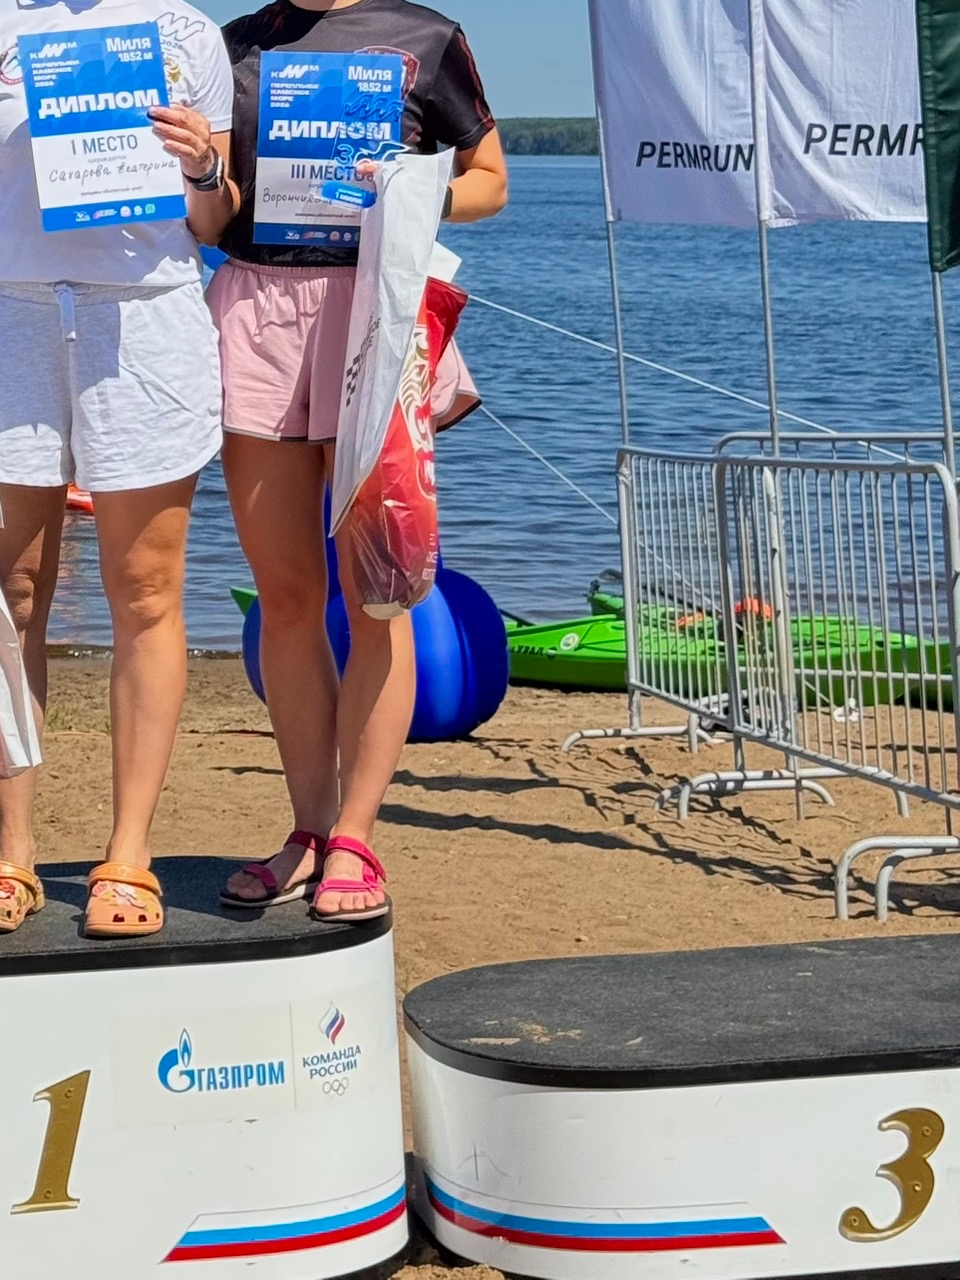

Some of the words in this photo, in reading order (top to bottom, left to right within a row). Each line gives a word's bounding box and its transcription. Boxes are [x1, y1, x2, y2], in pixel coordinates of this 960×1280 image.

[106, 36, 152, 53] Миля
[118, 51, 142, 63] 1852
[348, 65, 392, 81] Миля
[357, 82, 381, 93] 1852
[38, 88, 160, 119] ДИПЛОМ
[269, 119, 391, 141] ДИПЛОМ
[83, 134, 138, 154] МЕСТО
[334, 143, 355, 167] 3
[636, 141, 755, 172] PERMRUN
[310, 164, 365, 181] МЕСТО
[302, 1044, 362, 1069] КОМАНДА
[197, 1061, 286, 1093] ГАЗПРОМ
[309, 1058, 358, 1080] РОССИИ
[10, 1069, 92, 1216] 1
[838, 1107, 945, 1243] 3
